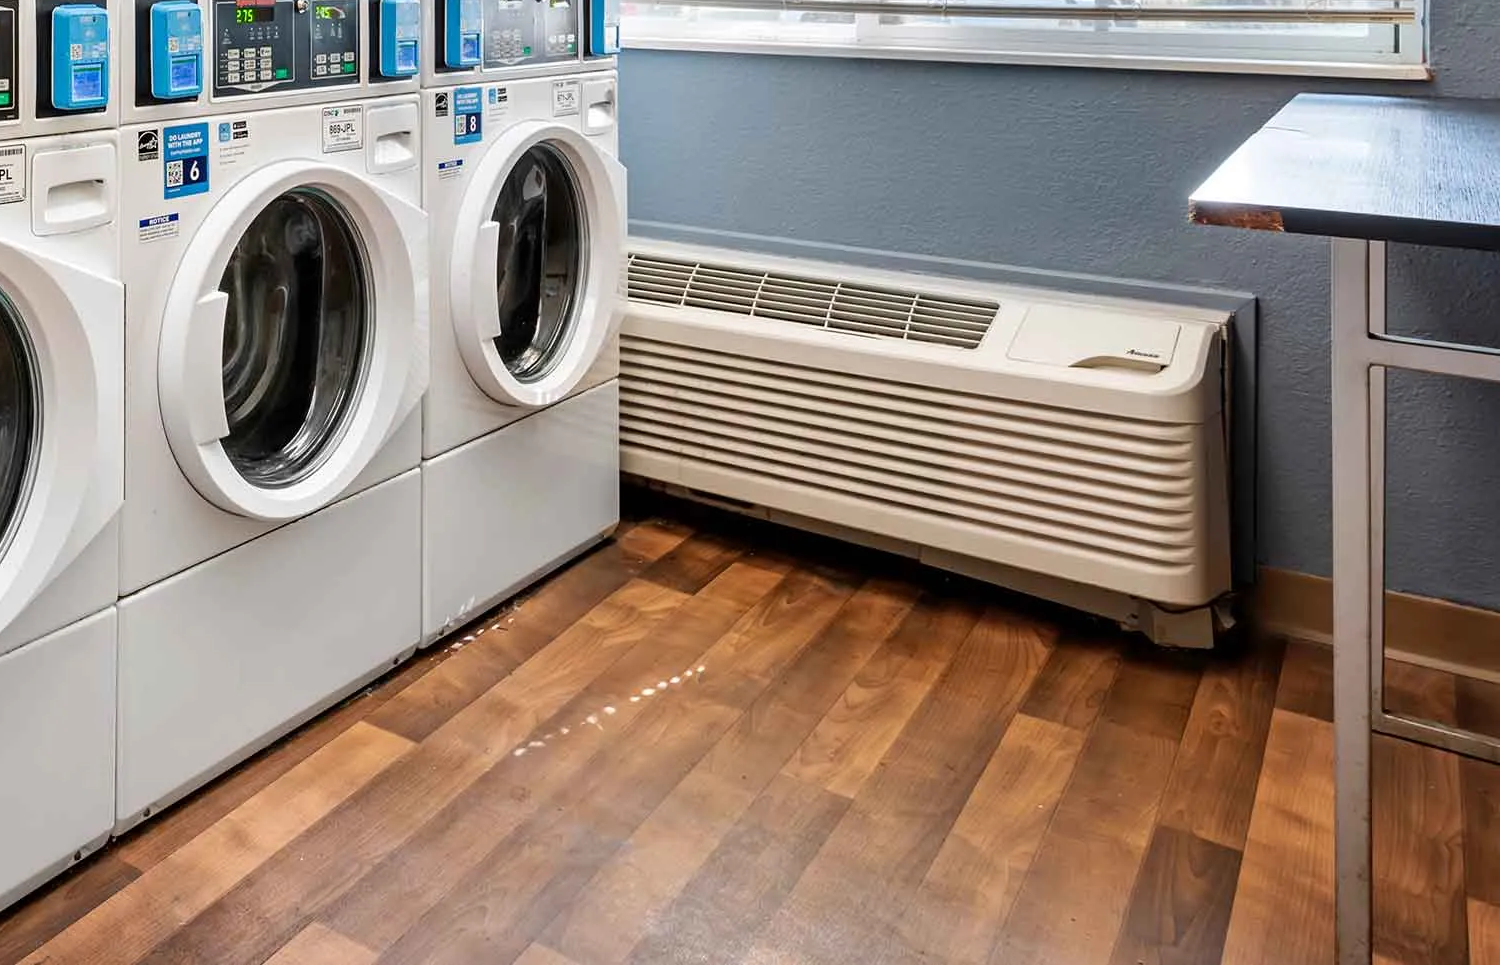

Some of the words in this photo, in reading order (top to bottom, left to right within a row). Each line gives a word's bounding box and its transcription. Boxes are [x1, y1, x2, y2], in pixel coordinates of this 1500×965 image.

[470, 116, 477, 132] 8
[190, 161, 200, 180] 6
[149, 216, 169, 226] NOTICE
